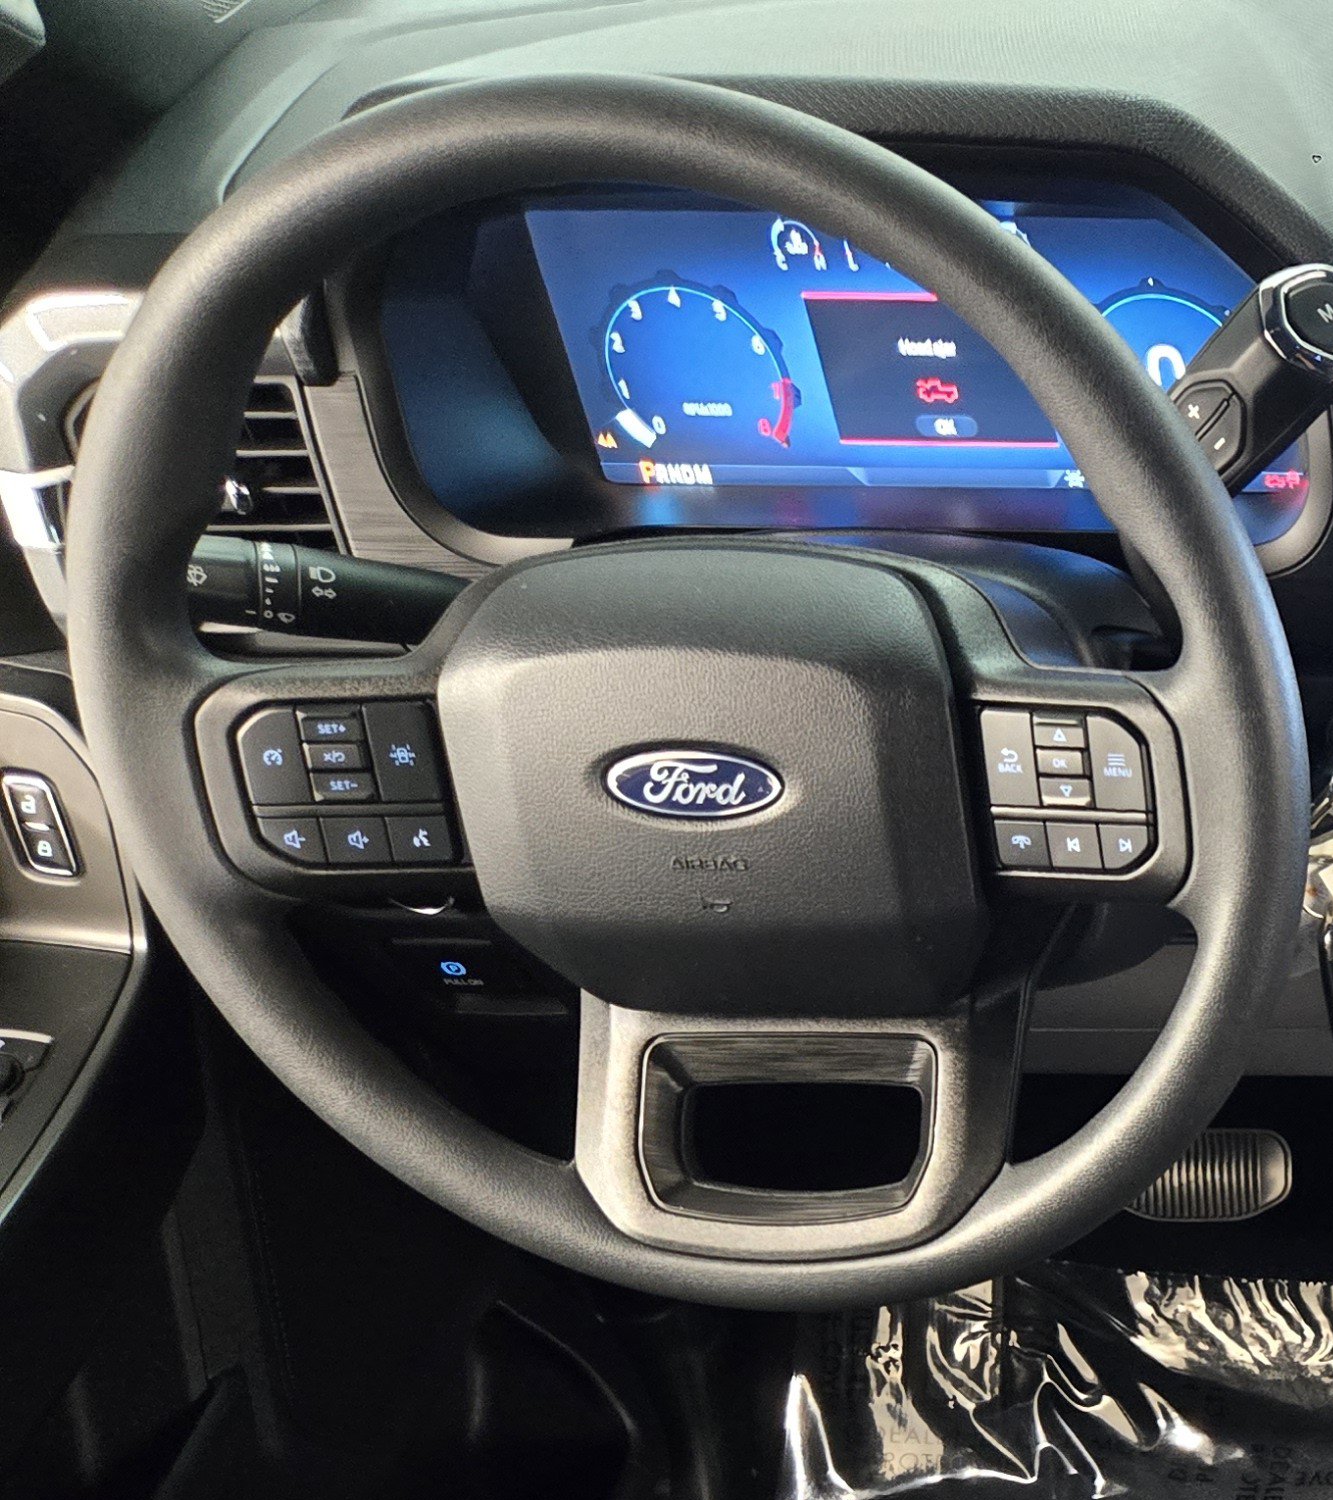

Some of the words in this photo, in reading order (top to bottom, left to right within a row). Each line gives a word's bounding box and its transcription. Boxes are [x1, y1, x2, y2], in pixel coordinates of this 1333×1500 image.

[997, 763, 1022, 774] BACK
[1053, 758, 1067, 768] OK
[1104, 767, 1132, 778] MENU
[643, 760, 746, 806] Ford
